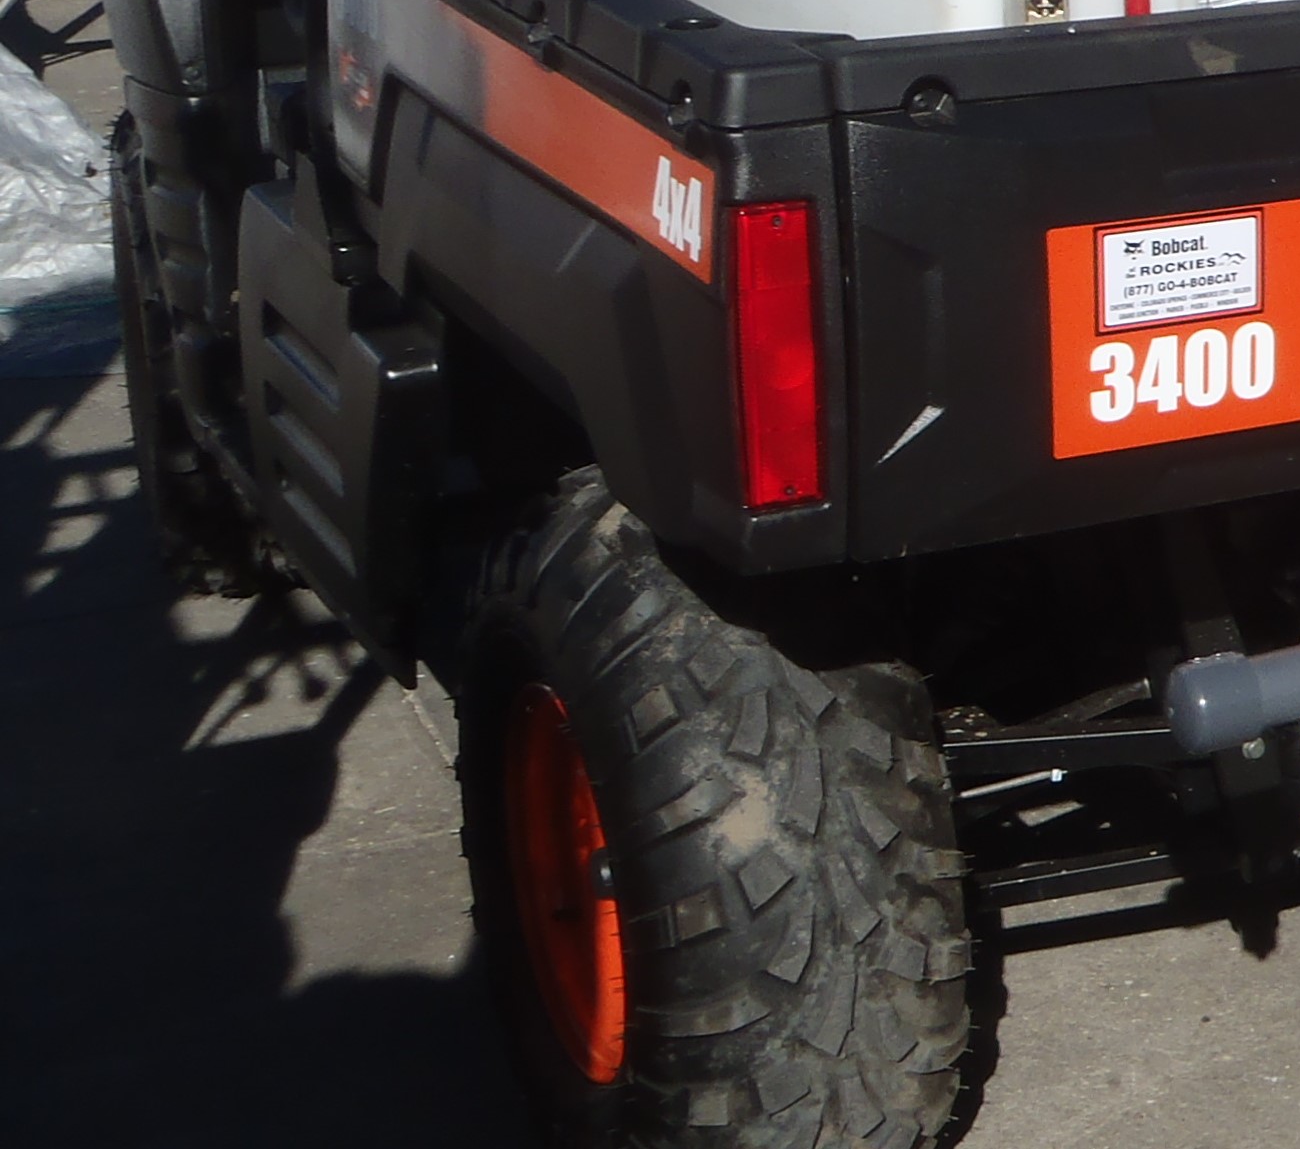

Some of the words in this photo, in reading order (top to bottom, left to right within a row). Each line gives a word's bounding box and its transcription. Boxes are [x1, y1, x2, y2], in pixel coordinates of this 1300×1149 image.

[652, 154, 702, 263] 4x4
[1151, 235, 1205, 257] Bobcat
[1139, 257, 1217, 277] ROCKIES
[1123, 283, 1155, 299] (877)
[1157, 272, 1238, 292] GO-4-BOBCAT
[1089, 321, 1276, 423] 3400
